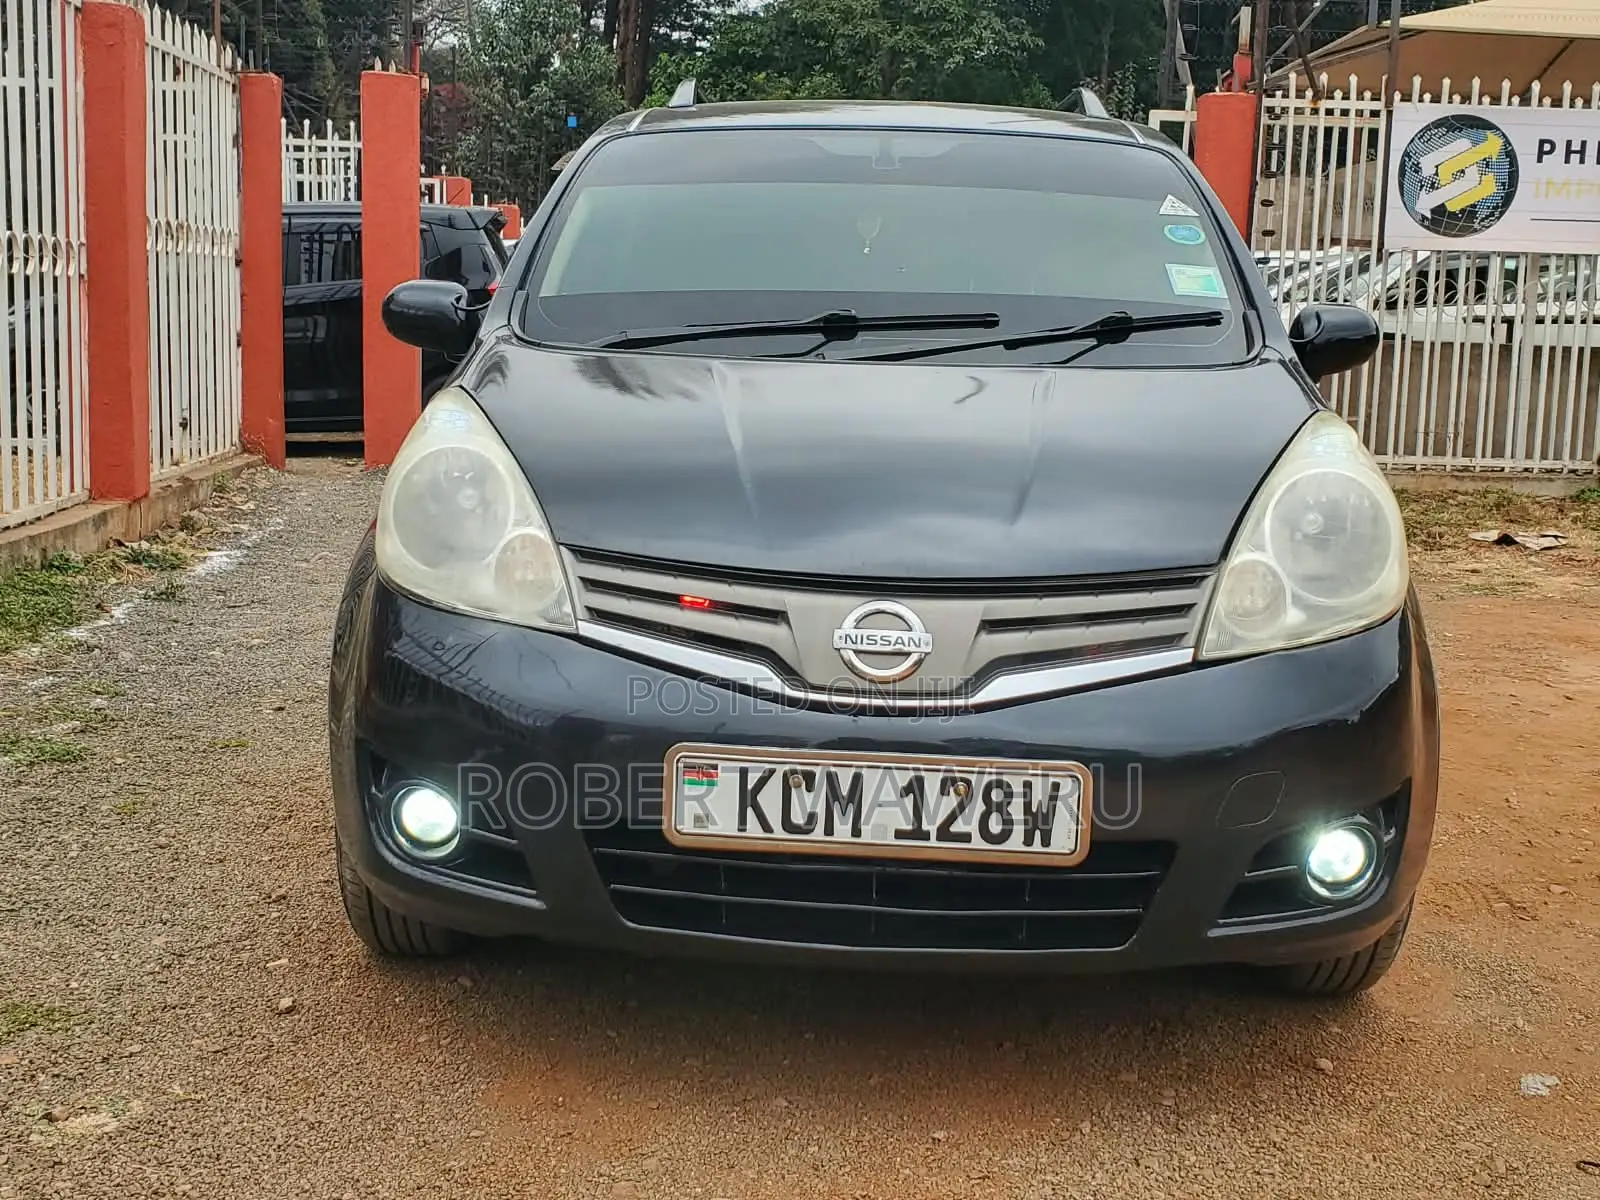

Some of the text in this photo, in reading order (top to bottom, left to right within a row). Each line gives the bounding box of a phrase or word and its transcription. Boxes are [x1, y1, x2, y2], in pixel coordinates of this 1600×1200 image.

[1534, 178, 1600, 199] IMP
[843, 633, 923, 649] NISSAN
[738, 766, 1061, 848] KCM 128W
